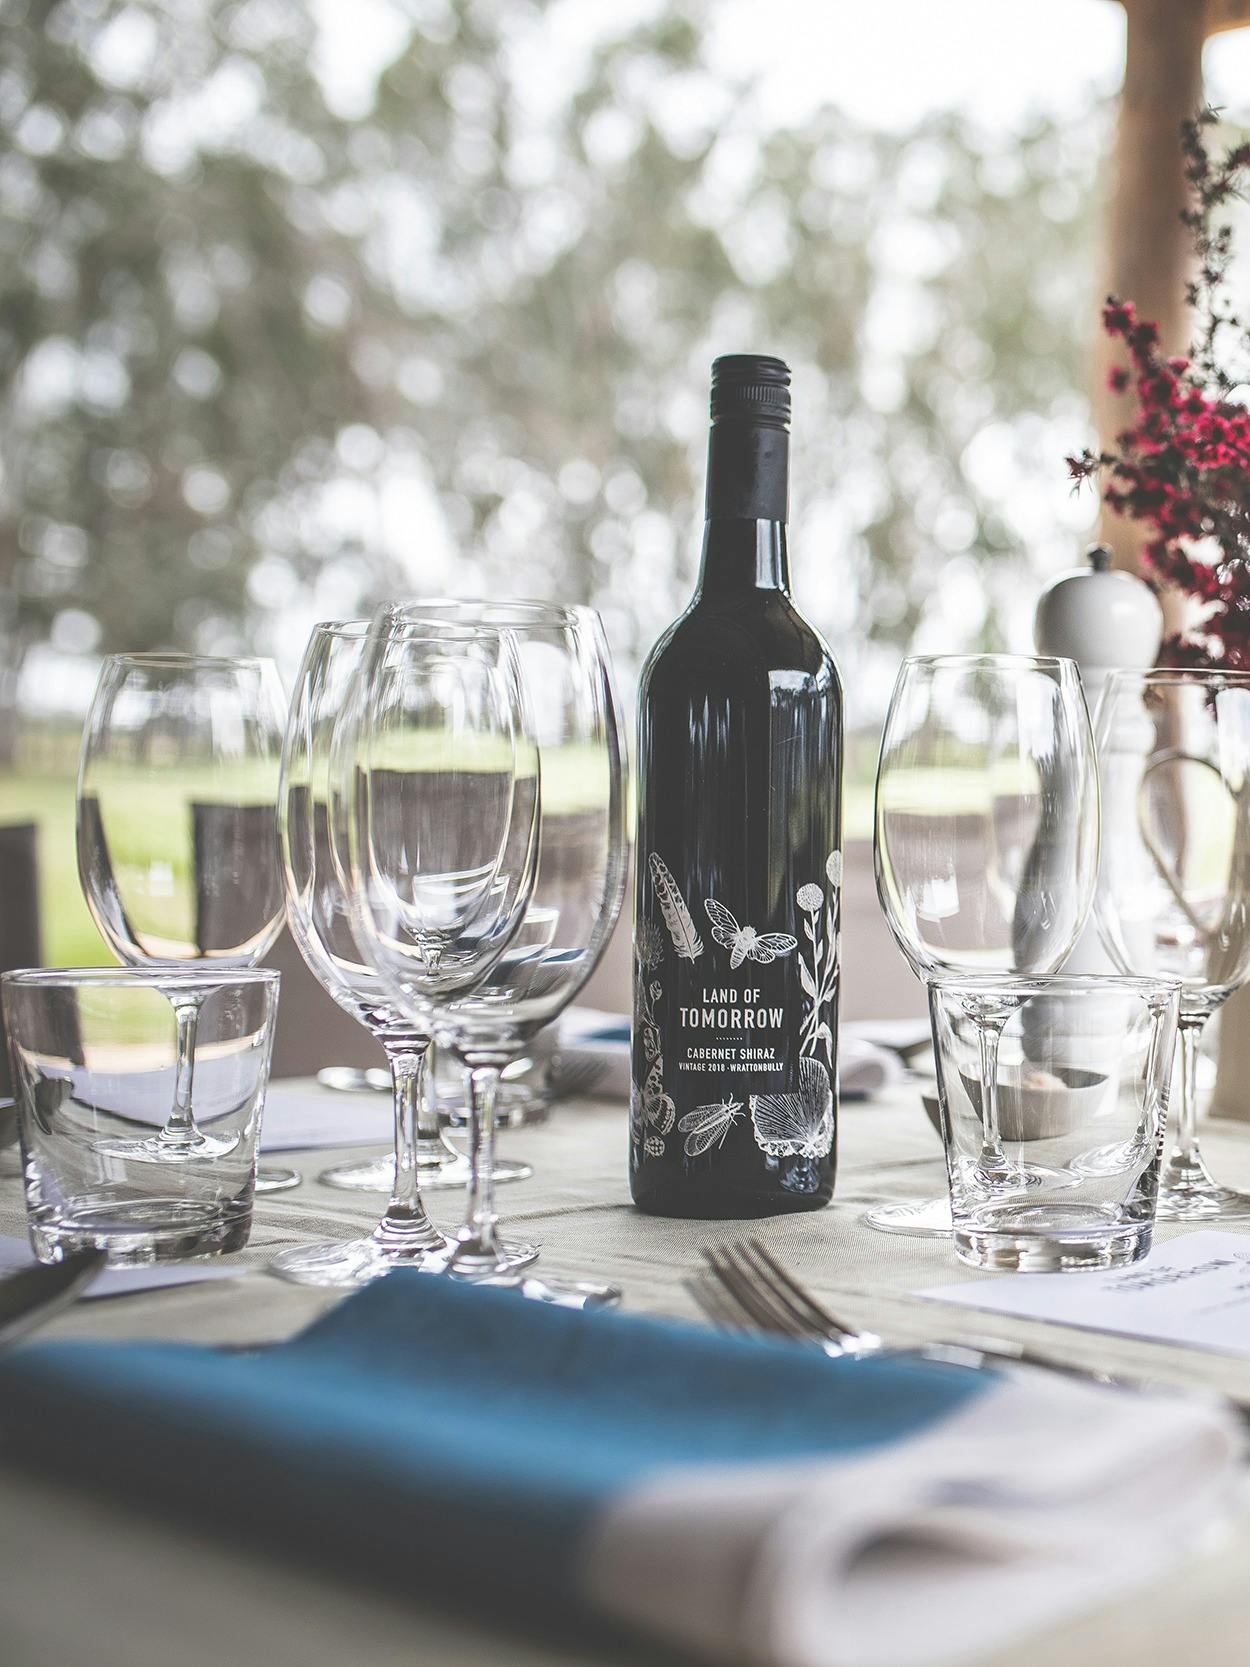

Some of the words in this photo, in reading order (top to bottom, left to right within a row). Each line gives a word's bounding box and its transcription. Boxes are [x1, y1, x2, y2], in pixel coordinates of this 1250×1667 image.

[702, 988, 738, 1004] LAND
[744, 988, 761, 1004] OF
[679, 1007, 784, 1029] TOMORROW
[687, 1047, 736, 1060] CABERNET
[740, 1047, 775, 1060] SHIRAZ
[678, 1062, 706, 1072] VINTAGE
[708, 1062, 725, 1072] 2018
[729, 1062, 784, 1072] WRATTONBULLY
